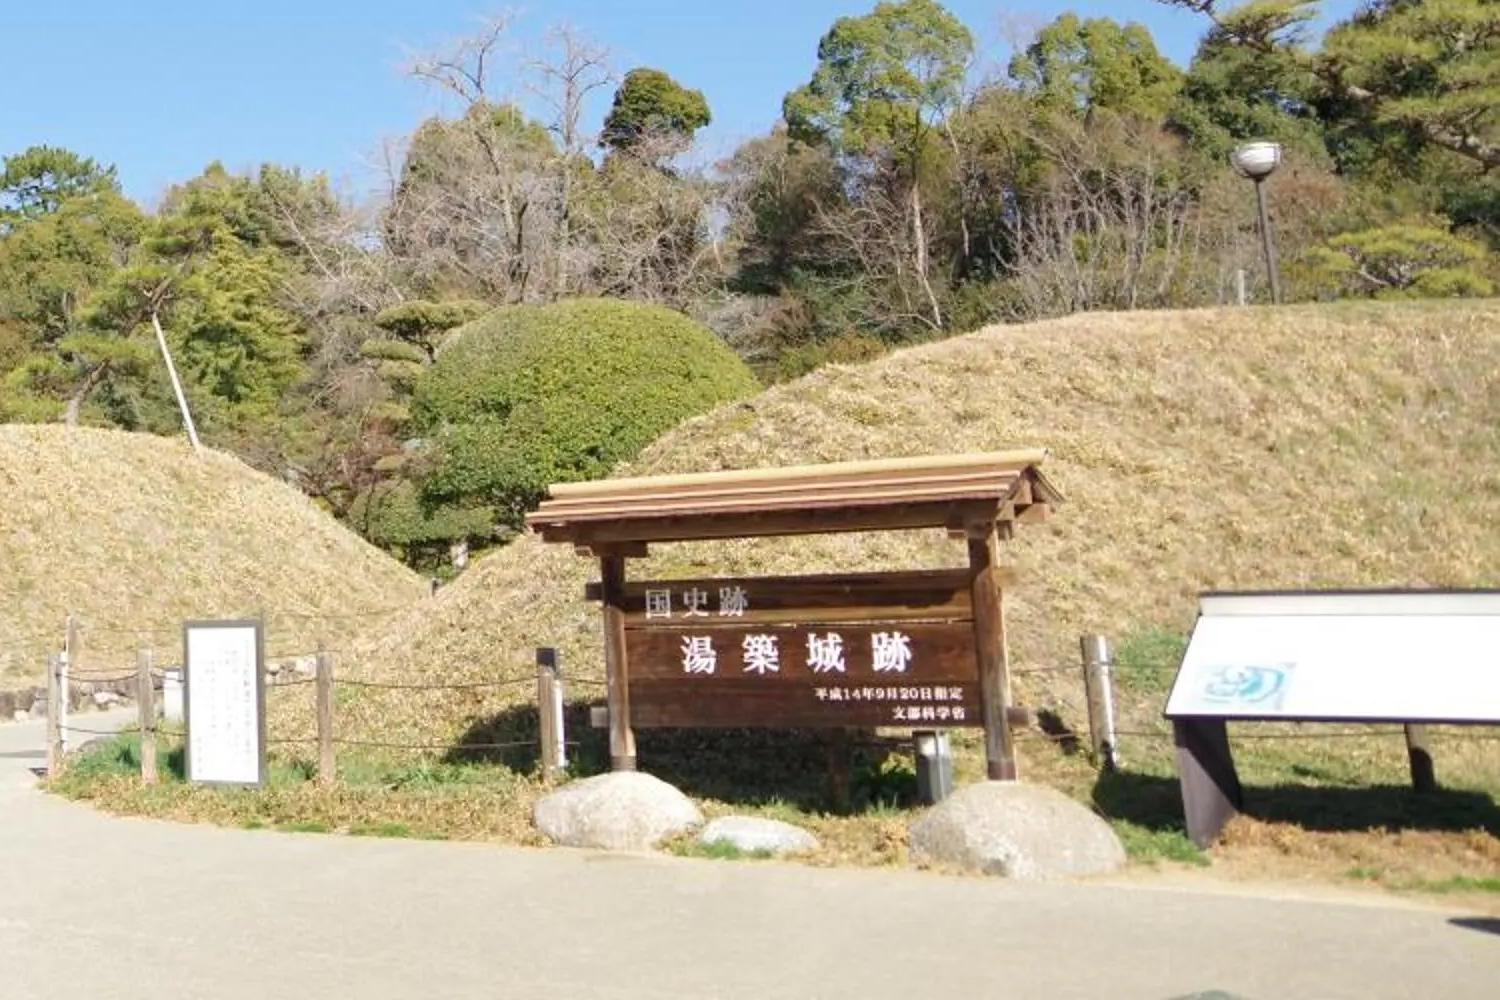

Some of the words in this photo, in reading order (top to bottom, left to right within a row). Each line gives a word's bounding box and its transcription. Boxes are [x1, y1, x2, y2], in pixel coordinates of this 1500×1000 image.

[645, 586, 749, 619] 国史跡
[680, 632, 912, 674] 湯築城跡
[813, 686, 964, 701] 平成14年9月20日指定
[891, 705, 966, 721] 文部科学省
